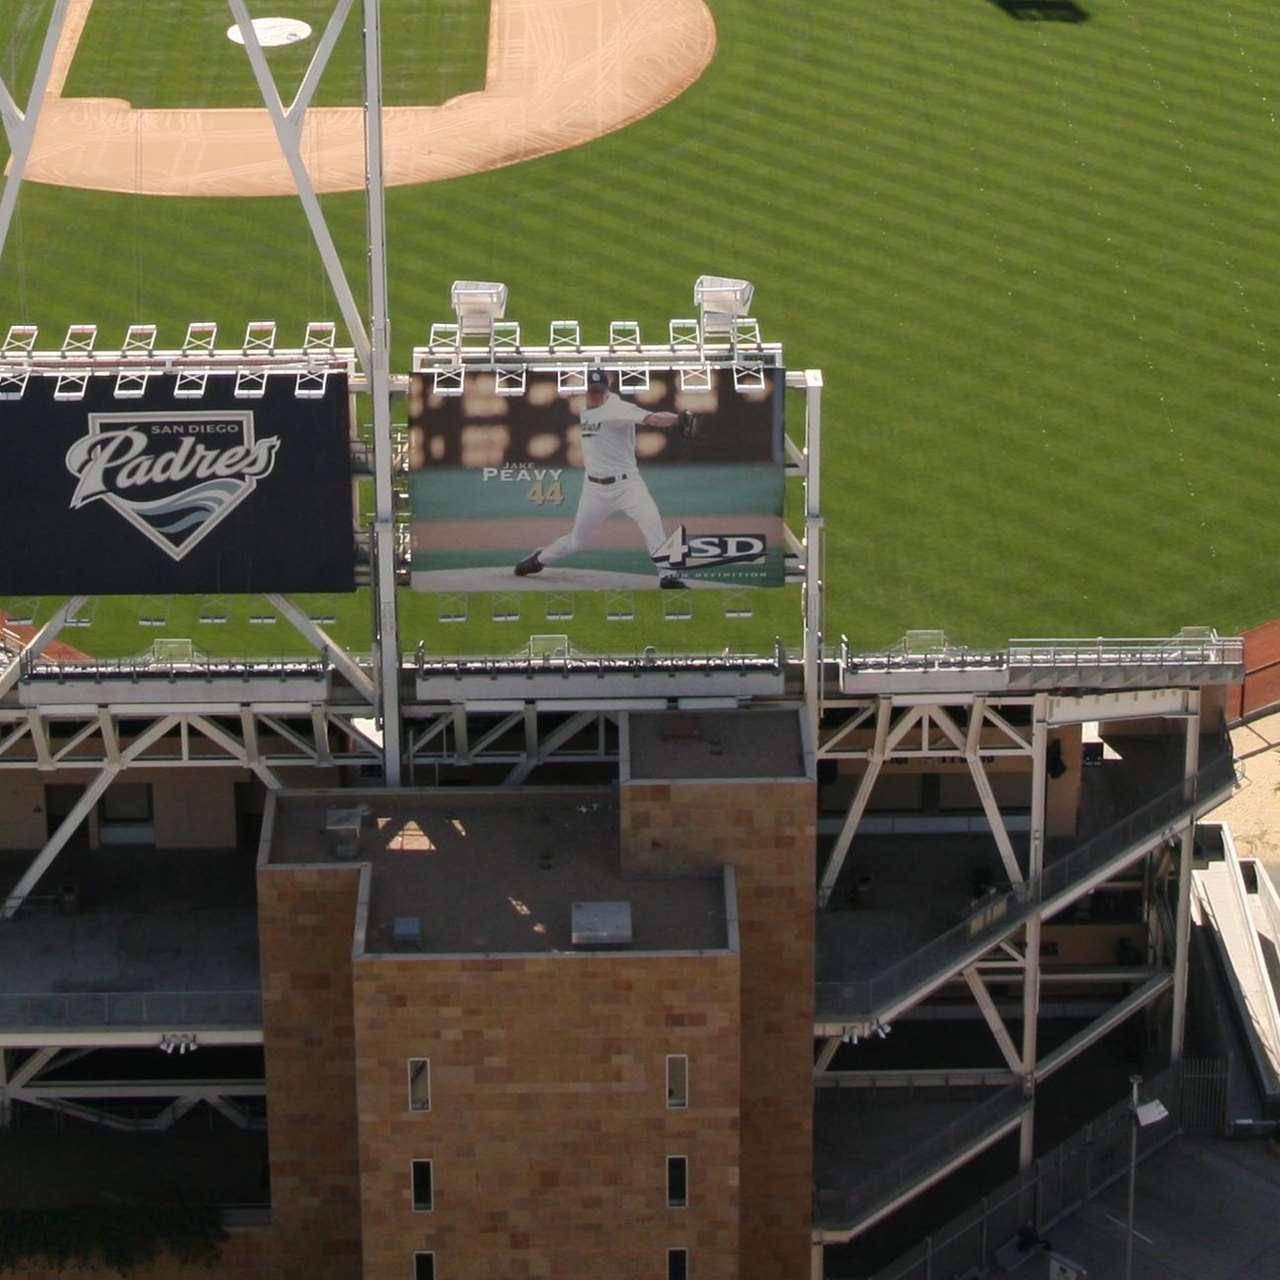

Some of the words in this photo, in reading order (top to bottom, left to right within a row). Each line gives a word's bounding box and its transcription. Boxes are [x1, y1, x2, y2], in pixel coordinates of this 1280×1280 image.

[151, 425, 185, 434] SAN
[188, 424, 239, 434] DIEGO
[66, 426, 280, 509] Padres
[503, 462, 534, 470] JAKE
[483, 468, 563, 481] PEAVY
[528, 480, 566, 504] 44
